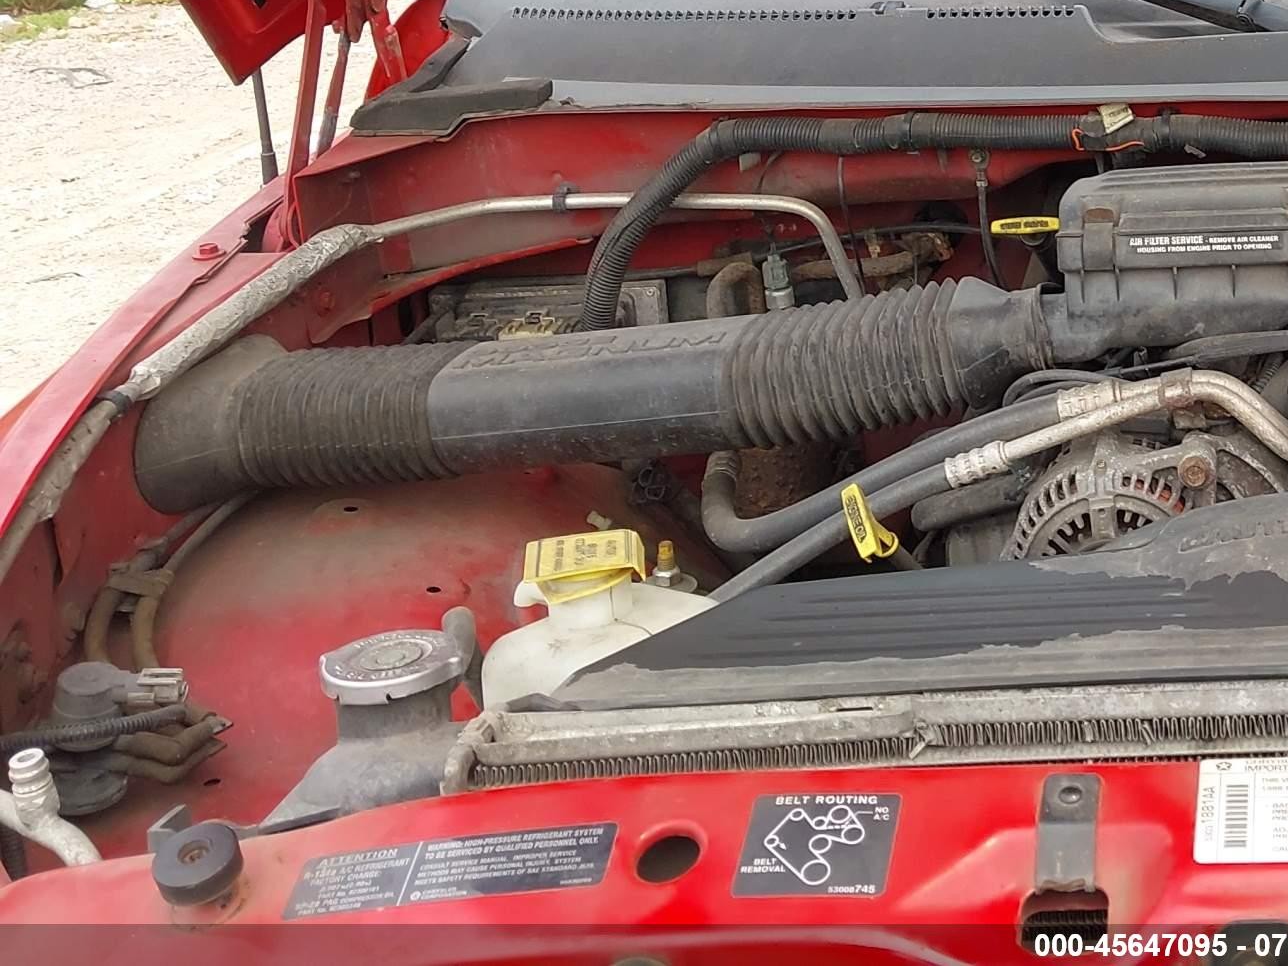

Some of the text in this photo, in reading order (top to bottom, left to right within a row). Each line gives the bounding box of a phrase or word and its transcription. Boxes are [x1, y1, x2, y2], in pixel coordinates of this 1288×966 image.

[1130, 238, 1142, 246] AIR
[1144, 237, 1170, 246] FILTER
[1171, 236, 1204, 245] SERVICE
[776, 796, 878, 805] BELT ROUTING
[875, 806, 888, 814] NO
[522, 830, 574, 841] REFRIGERANT
[574, 828, 604, 836] SYSTEM
[424, 852, 434, 860] TO
[447, 846, 482, 858] SERVICED
[483, 846, 494, 854] BY
[495, 842, 534, 852] QUALIFIED
[534, 838, 578, 848] PERSONNEL
[316, 848, 398, 868] ATTENTION
[754, 858, 776, 866] BELT
[740, 865, 786, 873] REMOVAL
